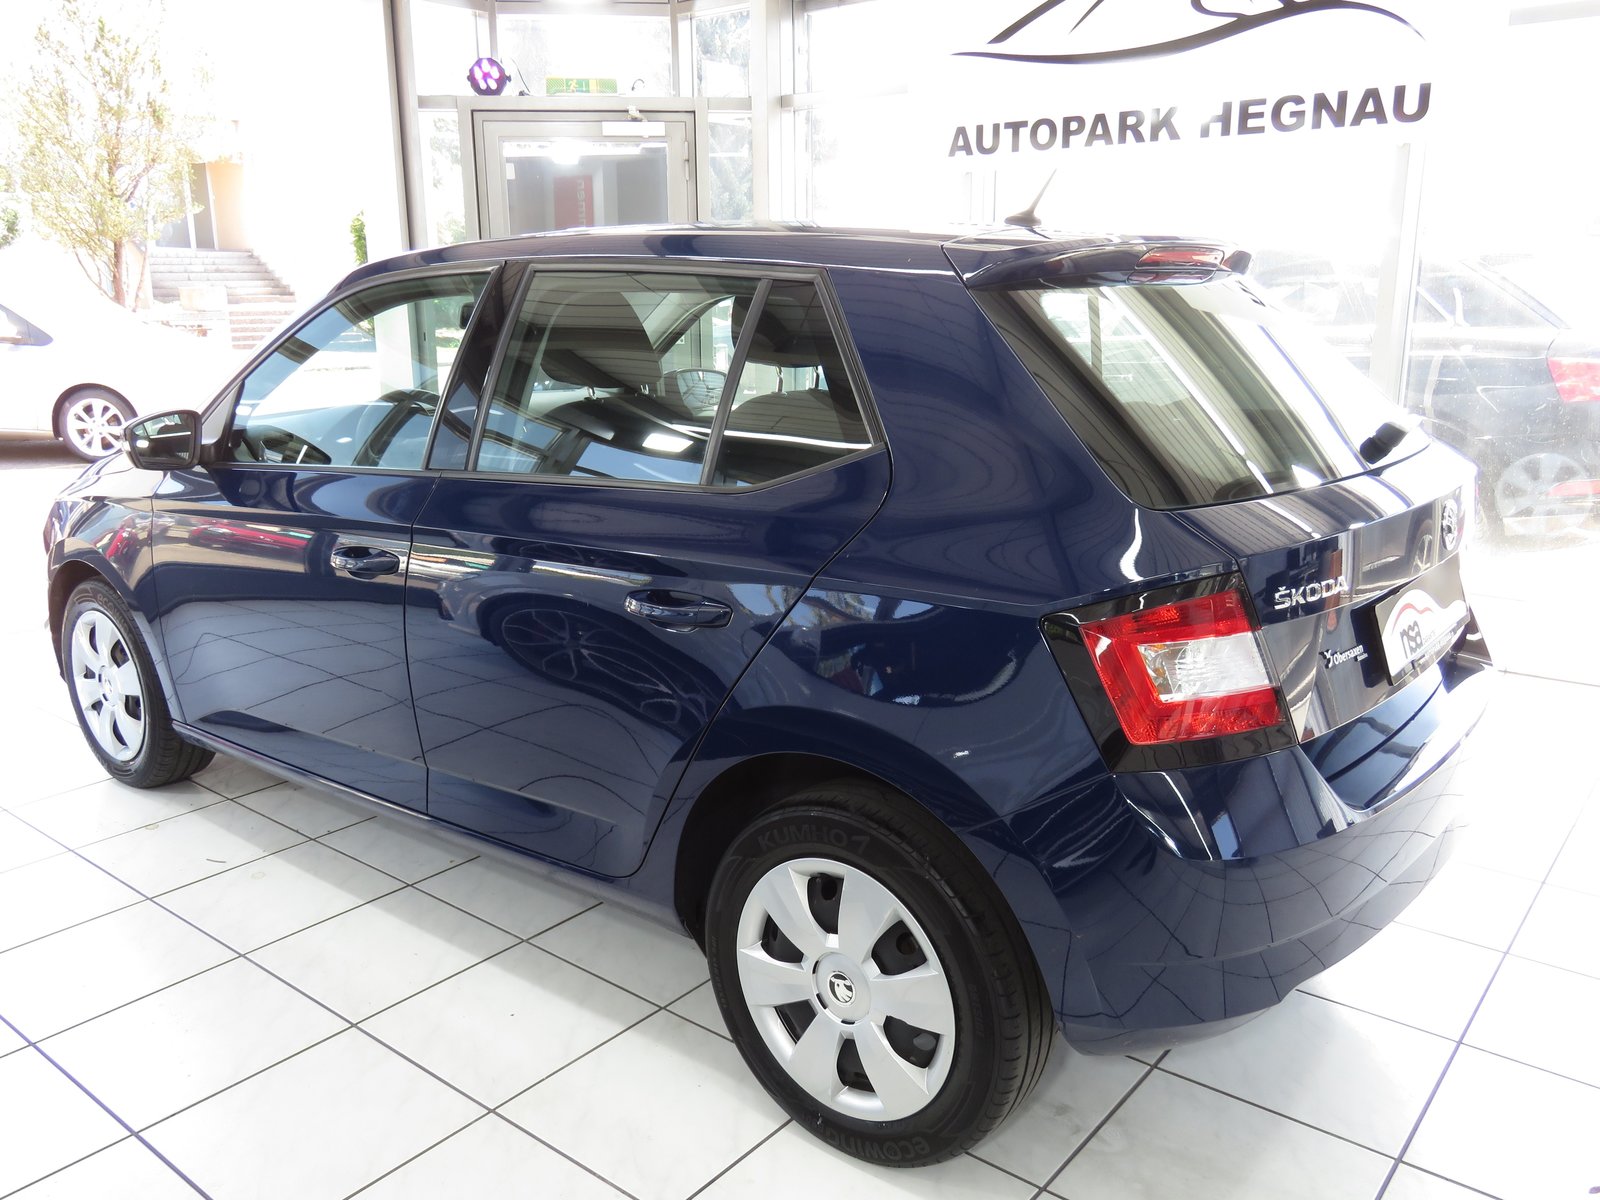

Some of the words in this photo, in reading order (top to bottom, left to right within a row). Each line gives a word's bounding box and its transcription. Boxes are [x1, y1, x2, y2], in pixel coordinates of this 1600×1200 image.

[947, 105, 1181, 157] AUTOPARK
[1200, 82, 1432, 139] HEGNAU
[1274, 576, 1349, 610] ŠKODA
[758, 825, 849, 852] KUMHO
